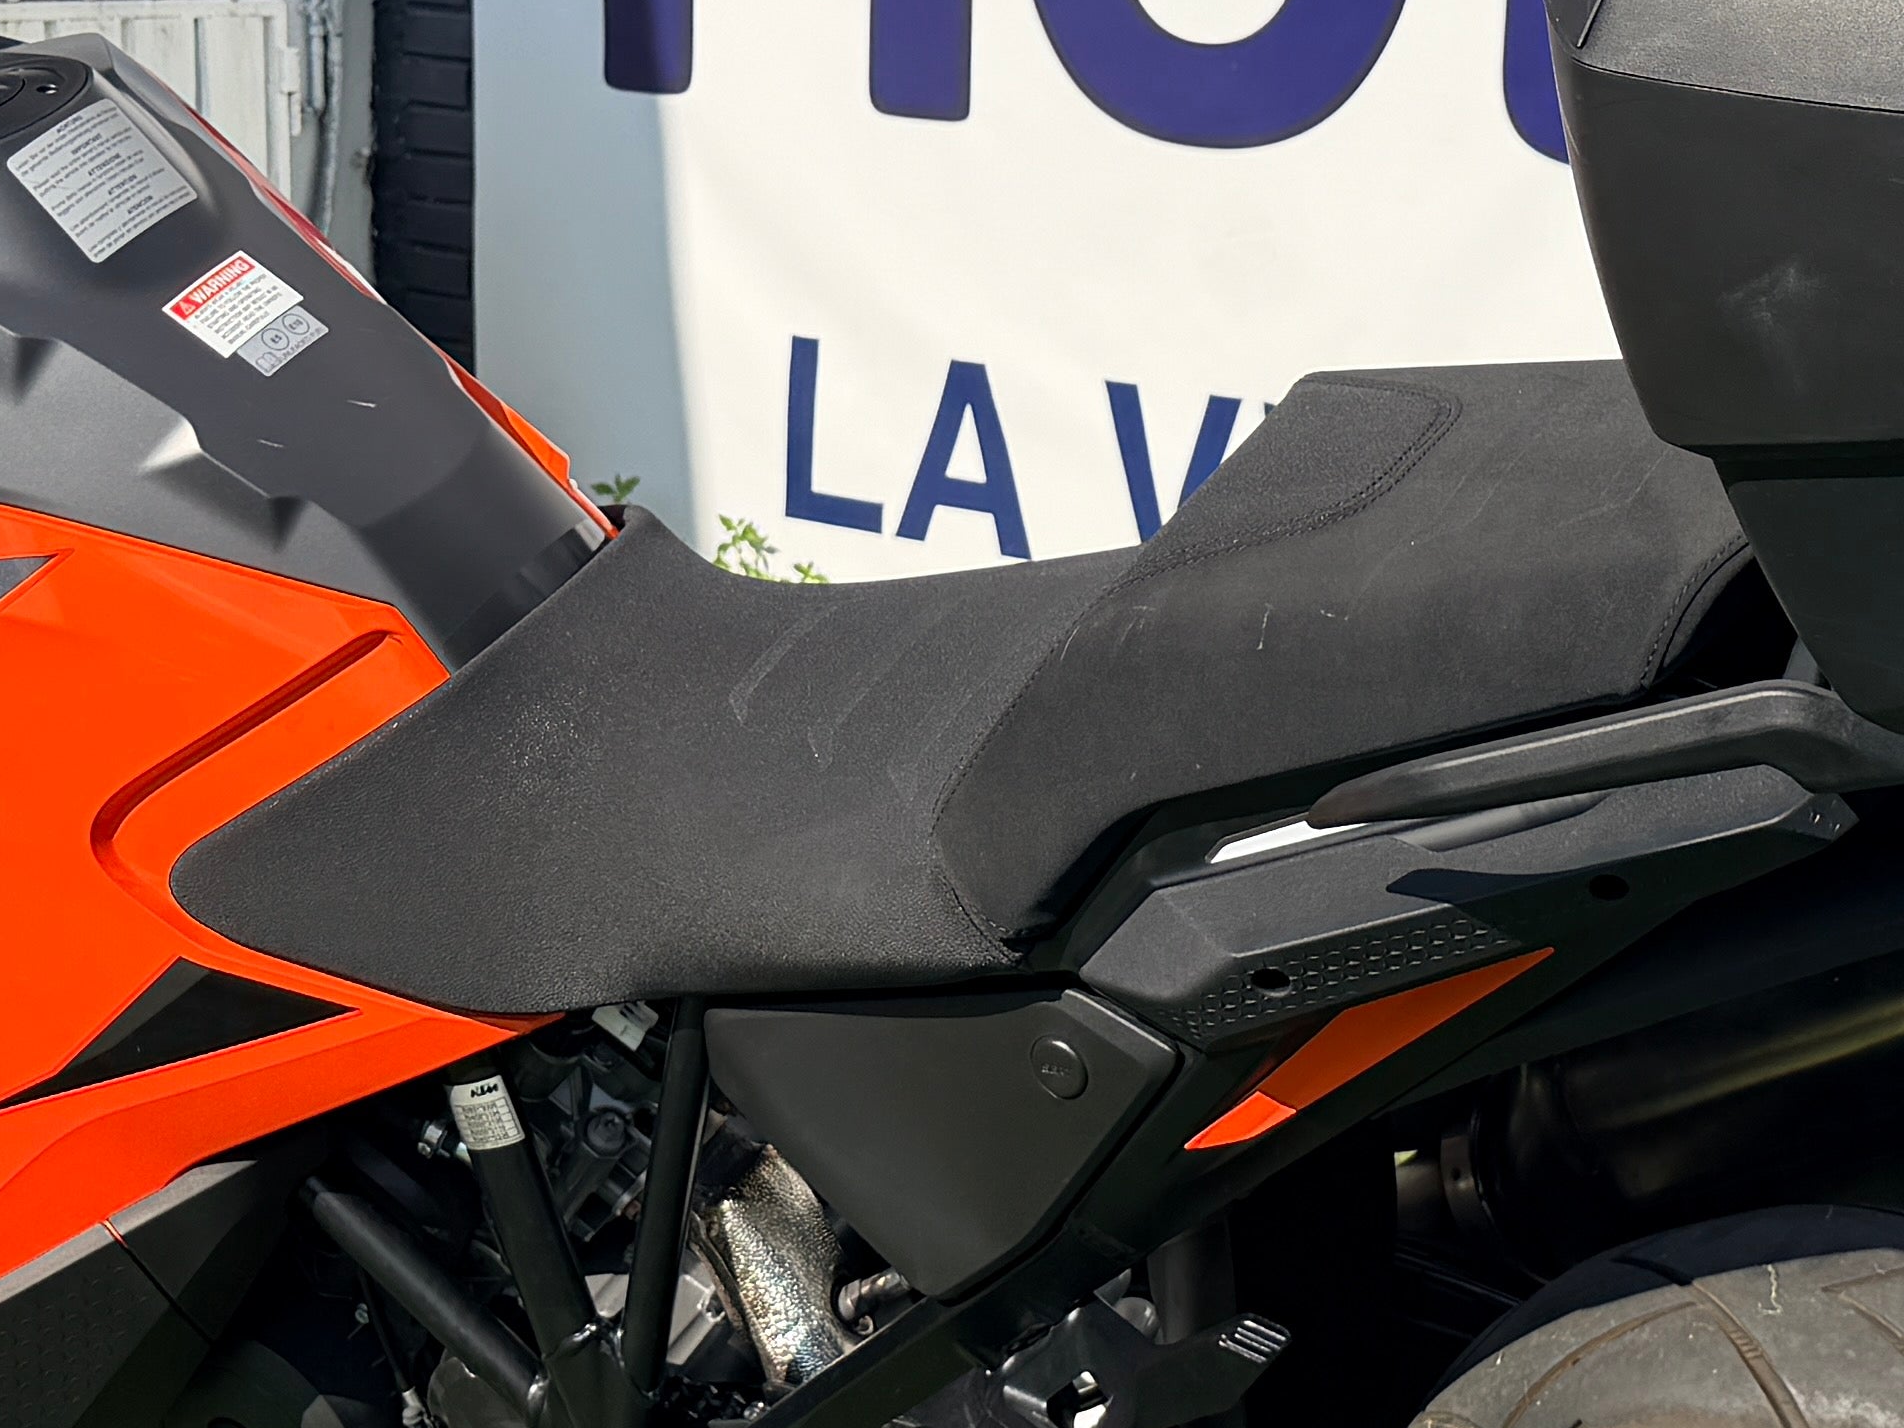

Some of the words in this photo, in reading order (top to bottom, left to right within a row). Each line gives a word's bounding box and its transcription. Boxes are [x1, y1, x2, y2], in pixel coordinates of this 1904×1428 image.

[190, 259, 249, 305] WARNING
[785, 335, 1033, 560] LA
[1104, 379, 1280, 544] V
